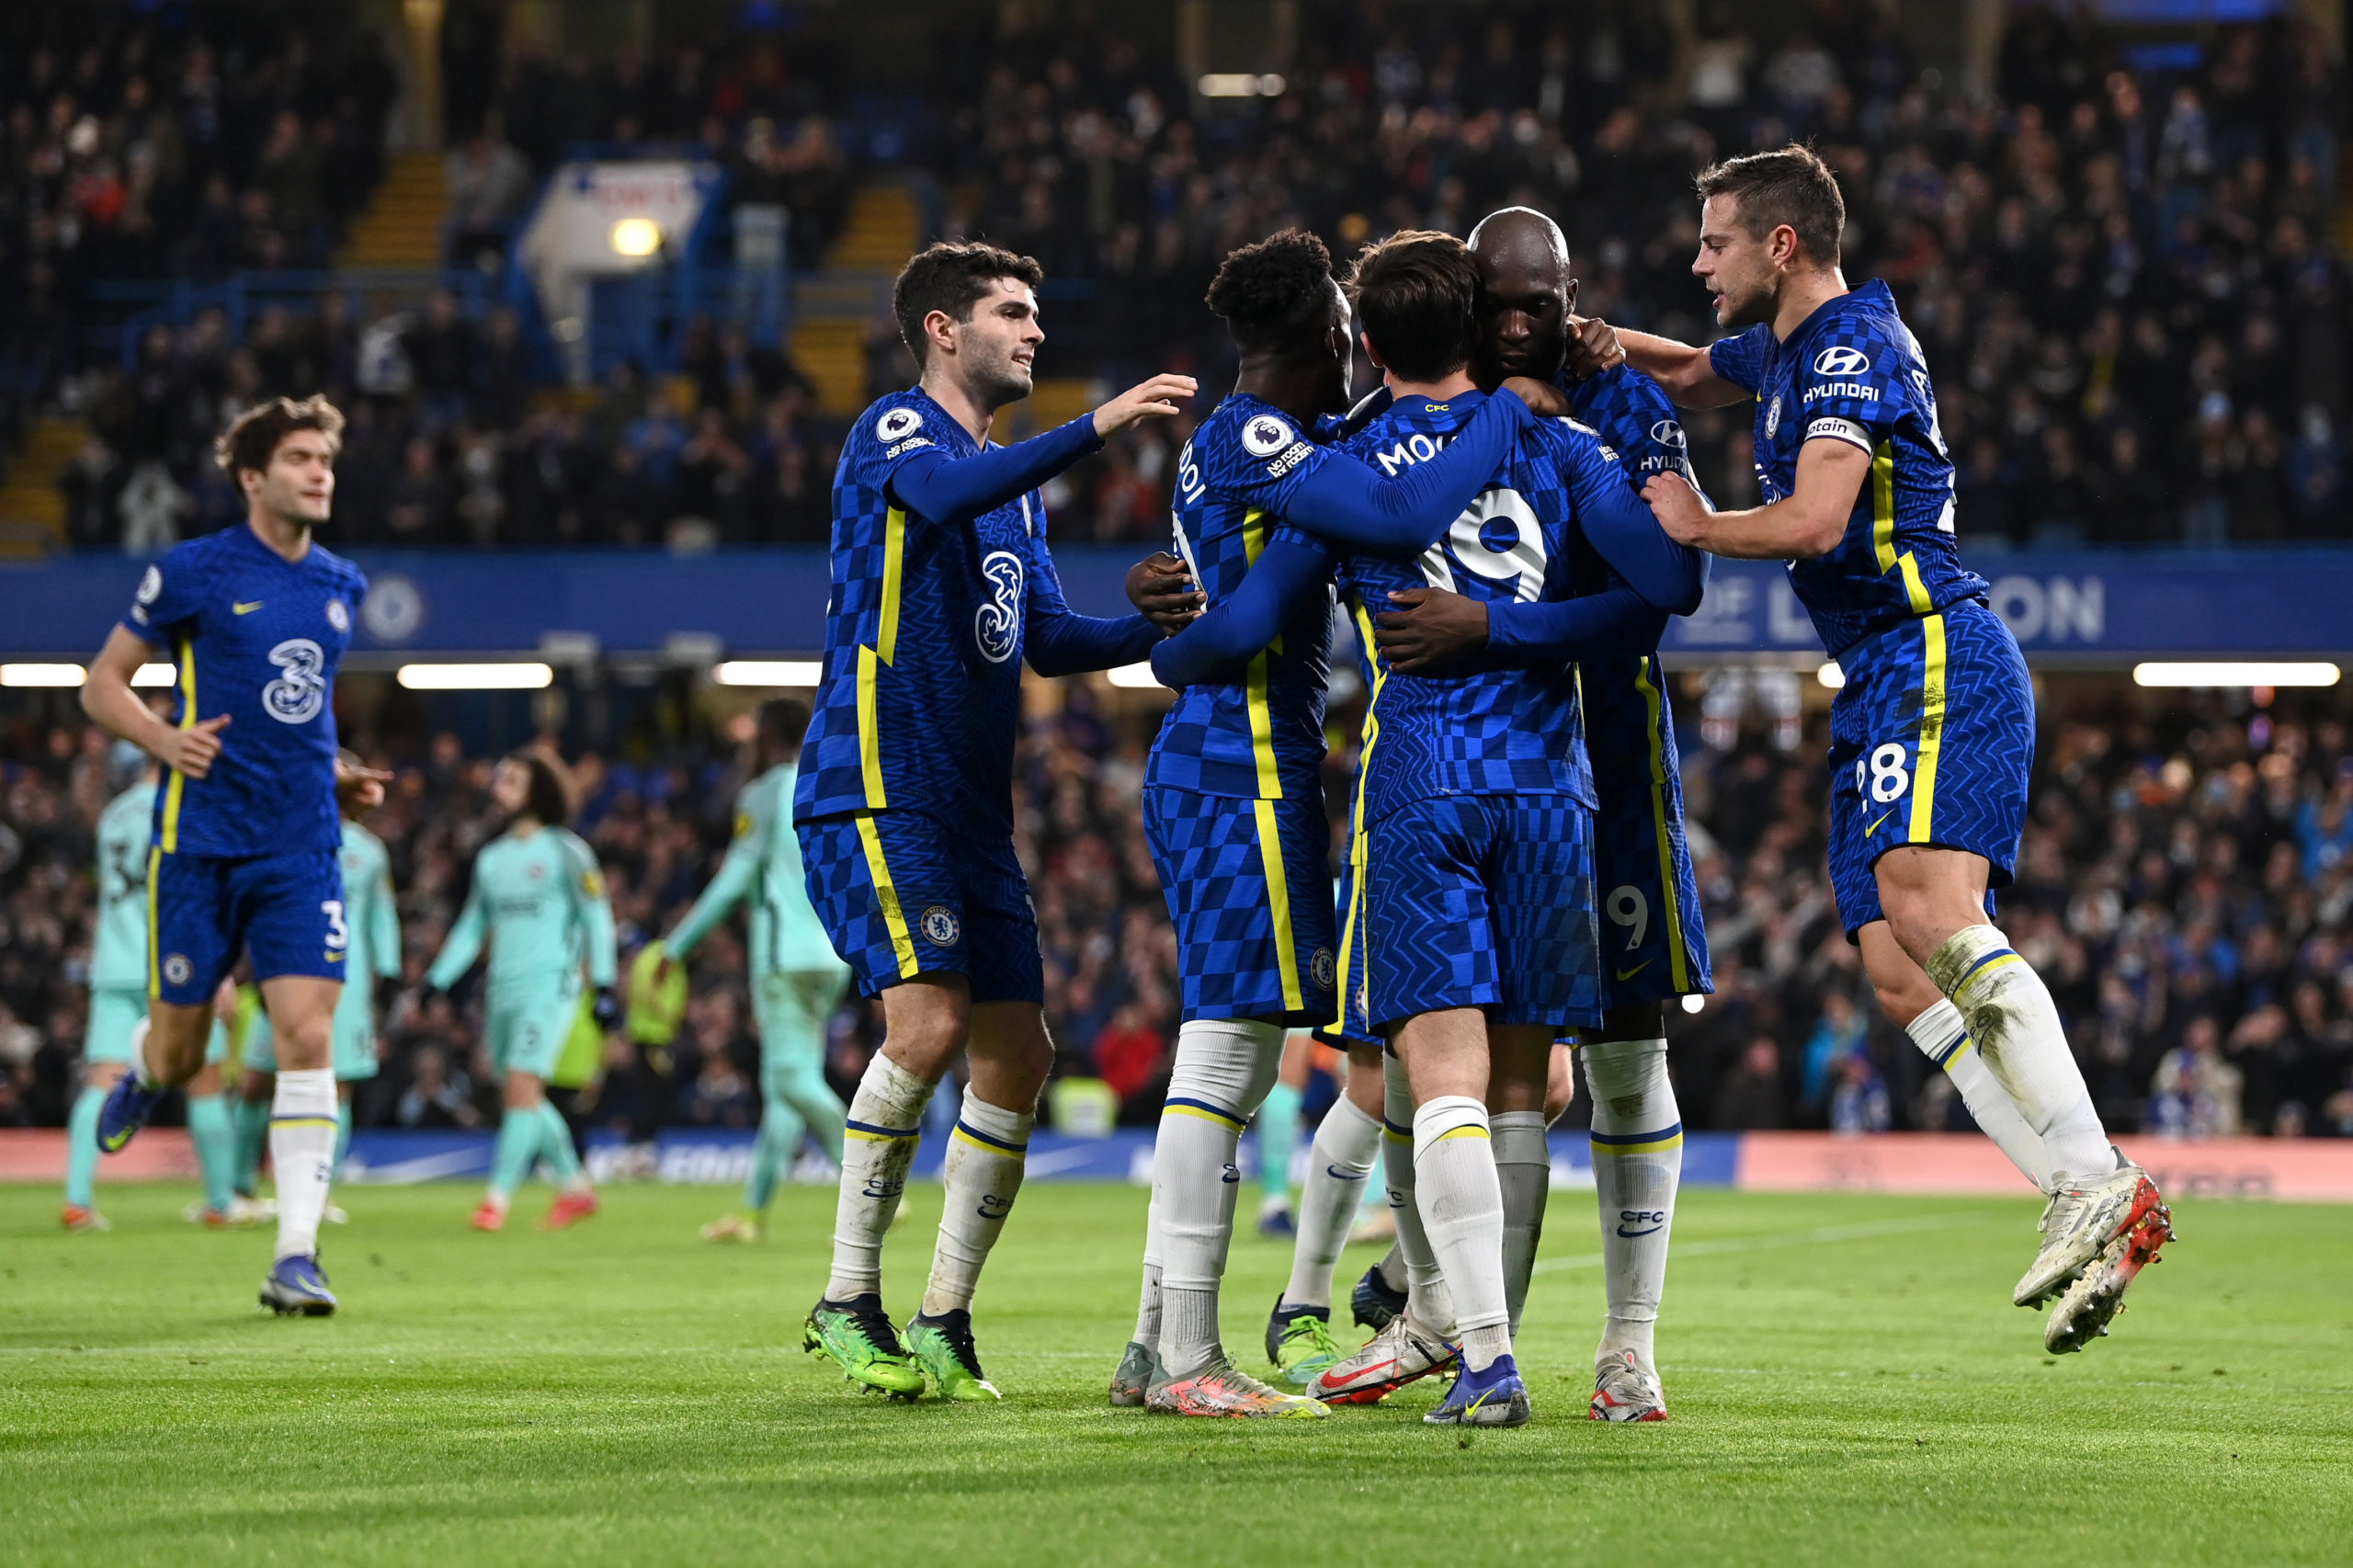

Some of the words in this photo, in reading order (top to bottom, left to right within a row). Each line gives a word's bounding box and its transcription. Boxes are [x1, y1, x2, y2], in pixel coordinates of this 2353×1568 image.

[1425, 404, 1449, 413] CFC
[1803, 382, 1880, 403] HYUNDAI
[1807, 420, 1847, 434] ptain
[1267, 460, 1284, 475] No
[1280, 441, 1306, 462] room
[1272, 465, 1288, 478] for
[1286, 446, 1315, 469] racism
[975, 551, 1023, 663] 3
[262, 638, 326, 724] 3
[321, 901, 349, 949] 3
[1606, 885, 1648, 950] 9
[869, 1179, 904, 1192] CFC
[1620, 1210, 1665, 1223] CFC
